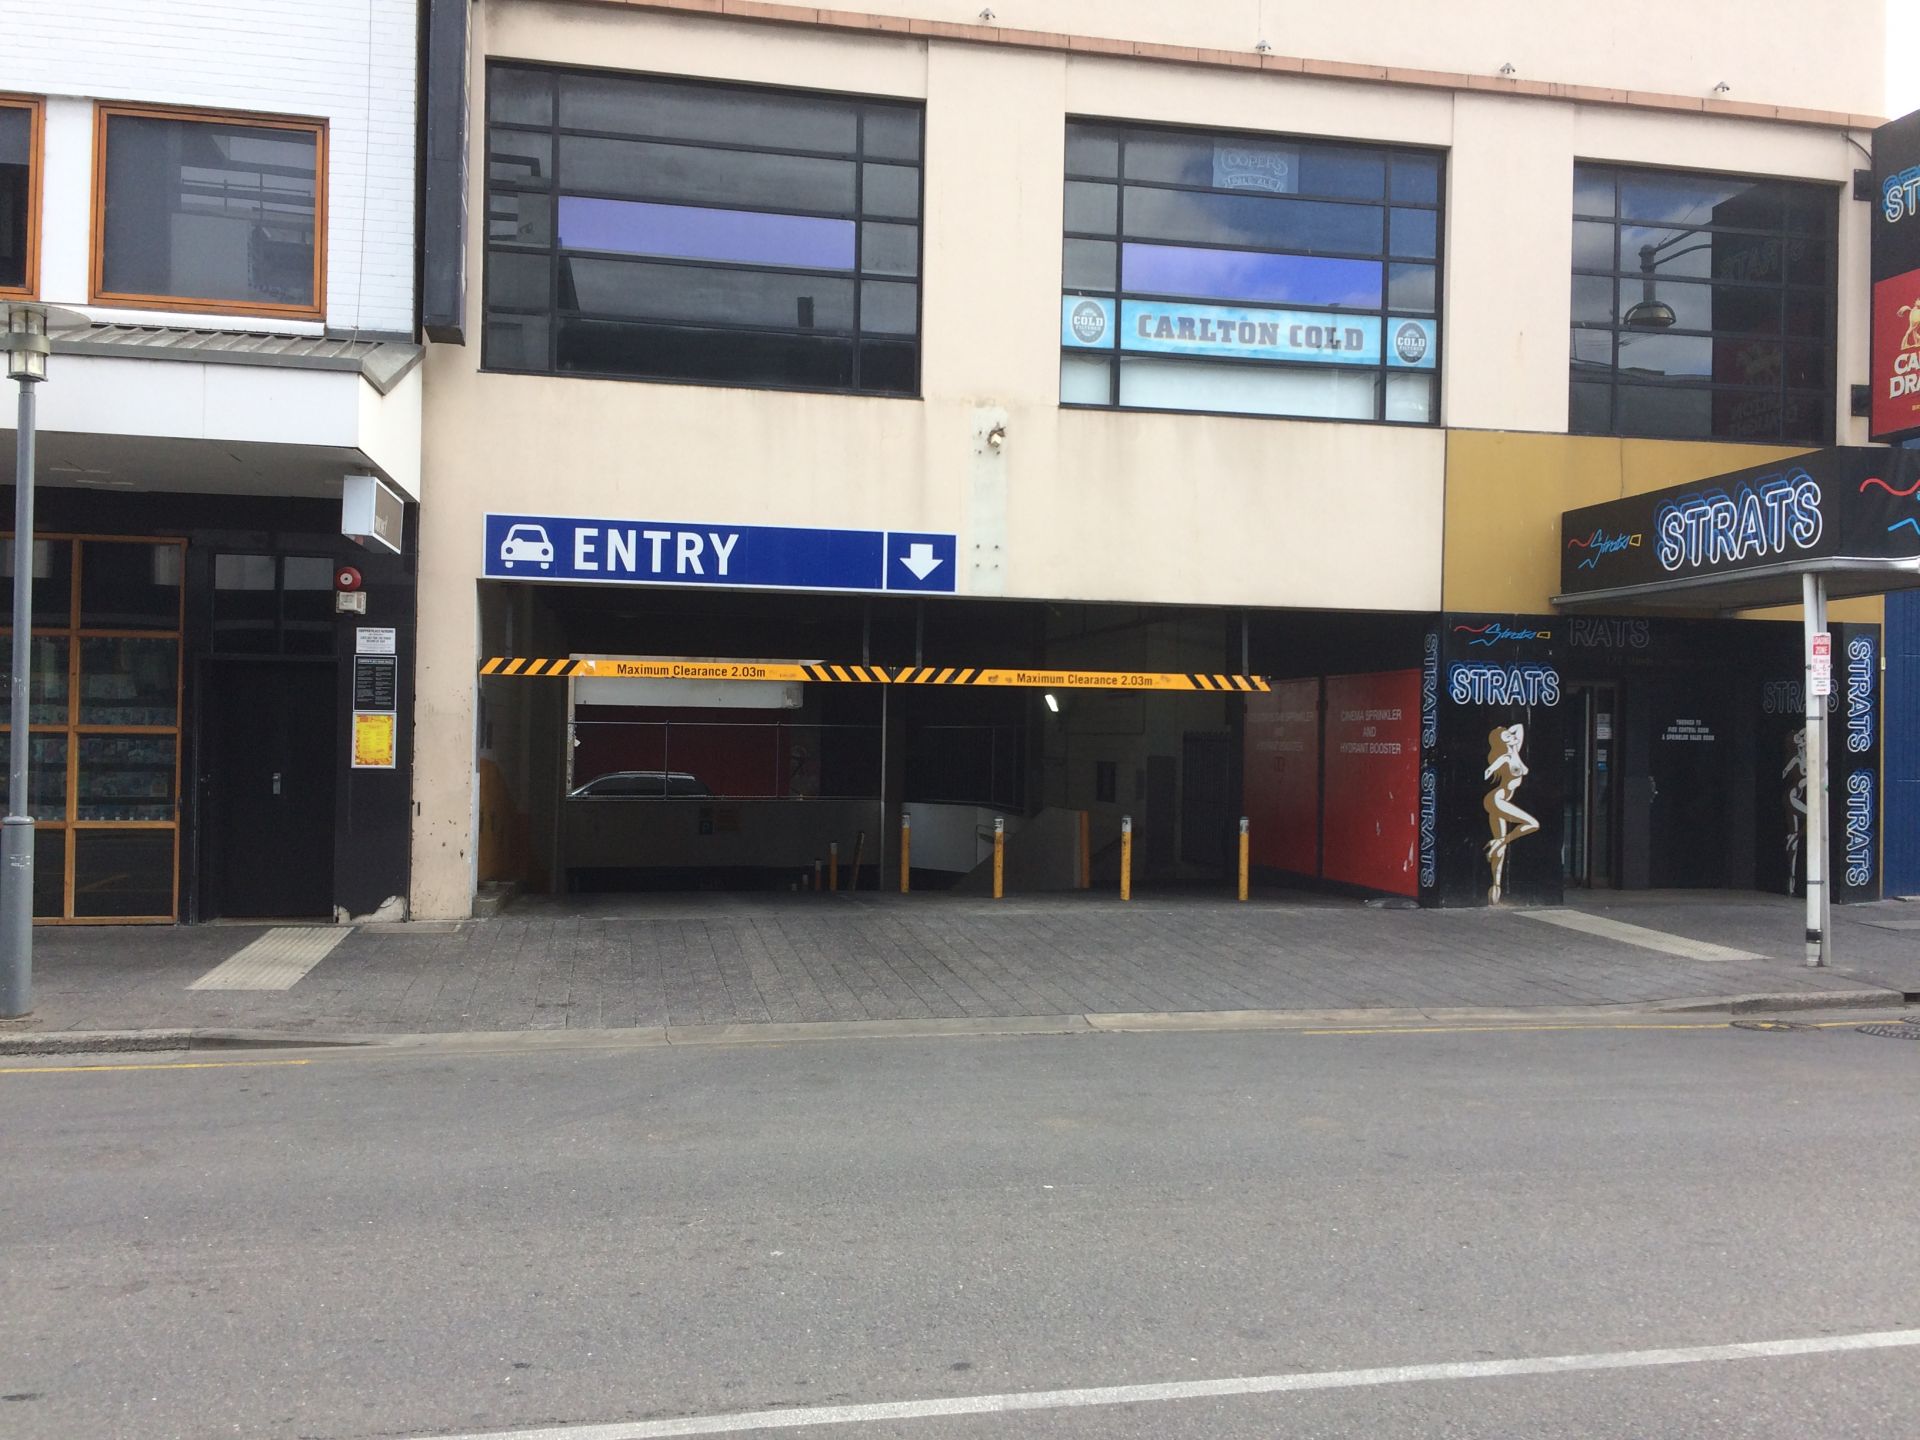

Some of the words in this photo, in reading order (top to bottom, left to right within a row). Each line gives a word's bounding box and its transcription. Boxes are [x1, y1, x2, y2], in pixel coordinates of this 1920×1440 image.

[1073, 315, 1104, 327] COLD
[1137, 314, 1280, 346] CARLTON
[1288, 325, 1364, 352] COLD
[1397, 336, 1426, 347] COLD
[1894, 350, 1920, 375] CA
[1889, 373, 1920, 399] DR
[1656, 468, 1823, 571] STRATS
[573, 527, 740, 576] ENTRY
[617, 663, 669, 677] Maximum
[673, 664, 728, 678] Clearance
[731, 666, 766, 678] 2.03m
[1016, 672, 1064, 685] Maximum
[1067, 673, 1118, 686] Clearance
[1121, 675, 1153, 687] 2.03m
[1448, 661, 1560, 707] STRATS
[1423, 633, 1440, 750] STRATS
[1763, 679, 1839, 714] STRS
[1847, 633, 1875, 754] STRATS
[1365, 708, 1402, 721] SPRINKLER
[1362, 727, 1377, 738] AND
[1369, 743, 1402, 754] BOOSTER
[1421, 771, 1437, 889] STRATS
[1846, 767, 1875, 888] STRATS
